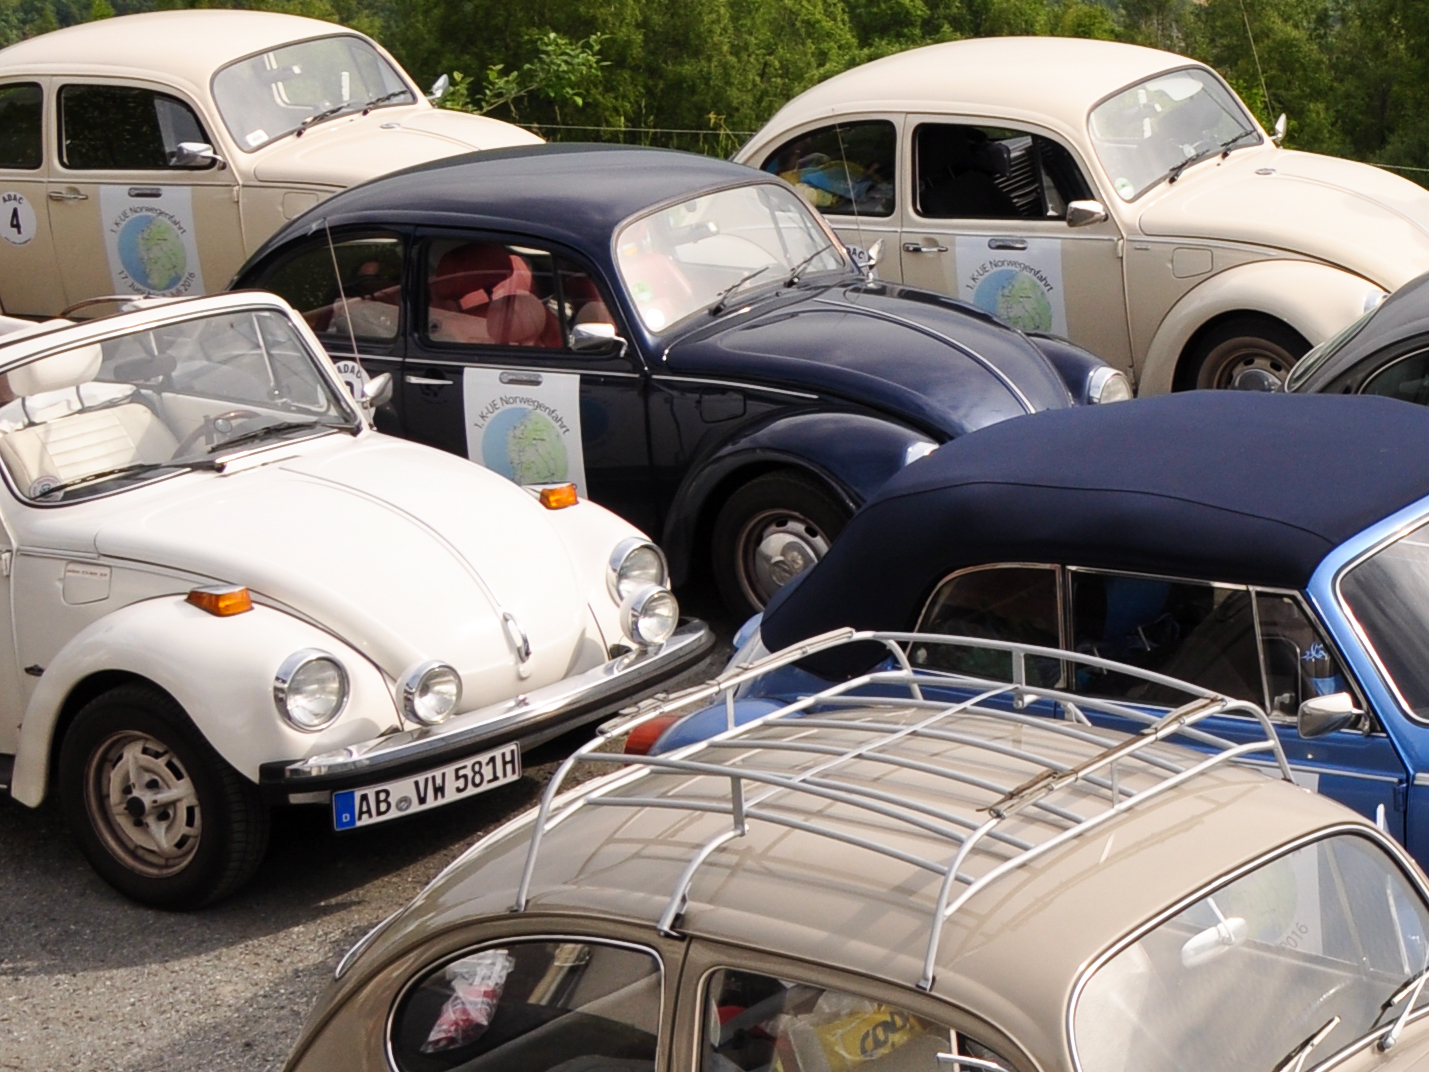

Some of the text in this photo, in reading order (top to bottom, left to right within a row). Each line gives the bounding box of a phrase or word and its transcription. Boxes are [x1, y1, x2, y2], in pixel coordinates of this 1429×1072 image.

[10, 206, 22, 235] 4
[129, 205, 188, 235] Norwegenfahrt
[971, 263, 989, 283] K-UE
[989, 258, 1054, 293] Norwegenfahrt
[481, 401, 501, 422] K-UE
[500, 394, 571, 435] Norwegenfahrt
[357, 788, 392, 822] AB
[413, 771, 447, 806] VW
[454, 748, 517, 795] 581H
